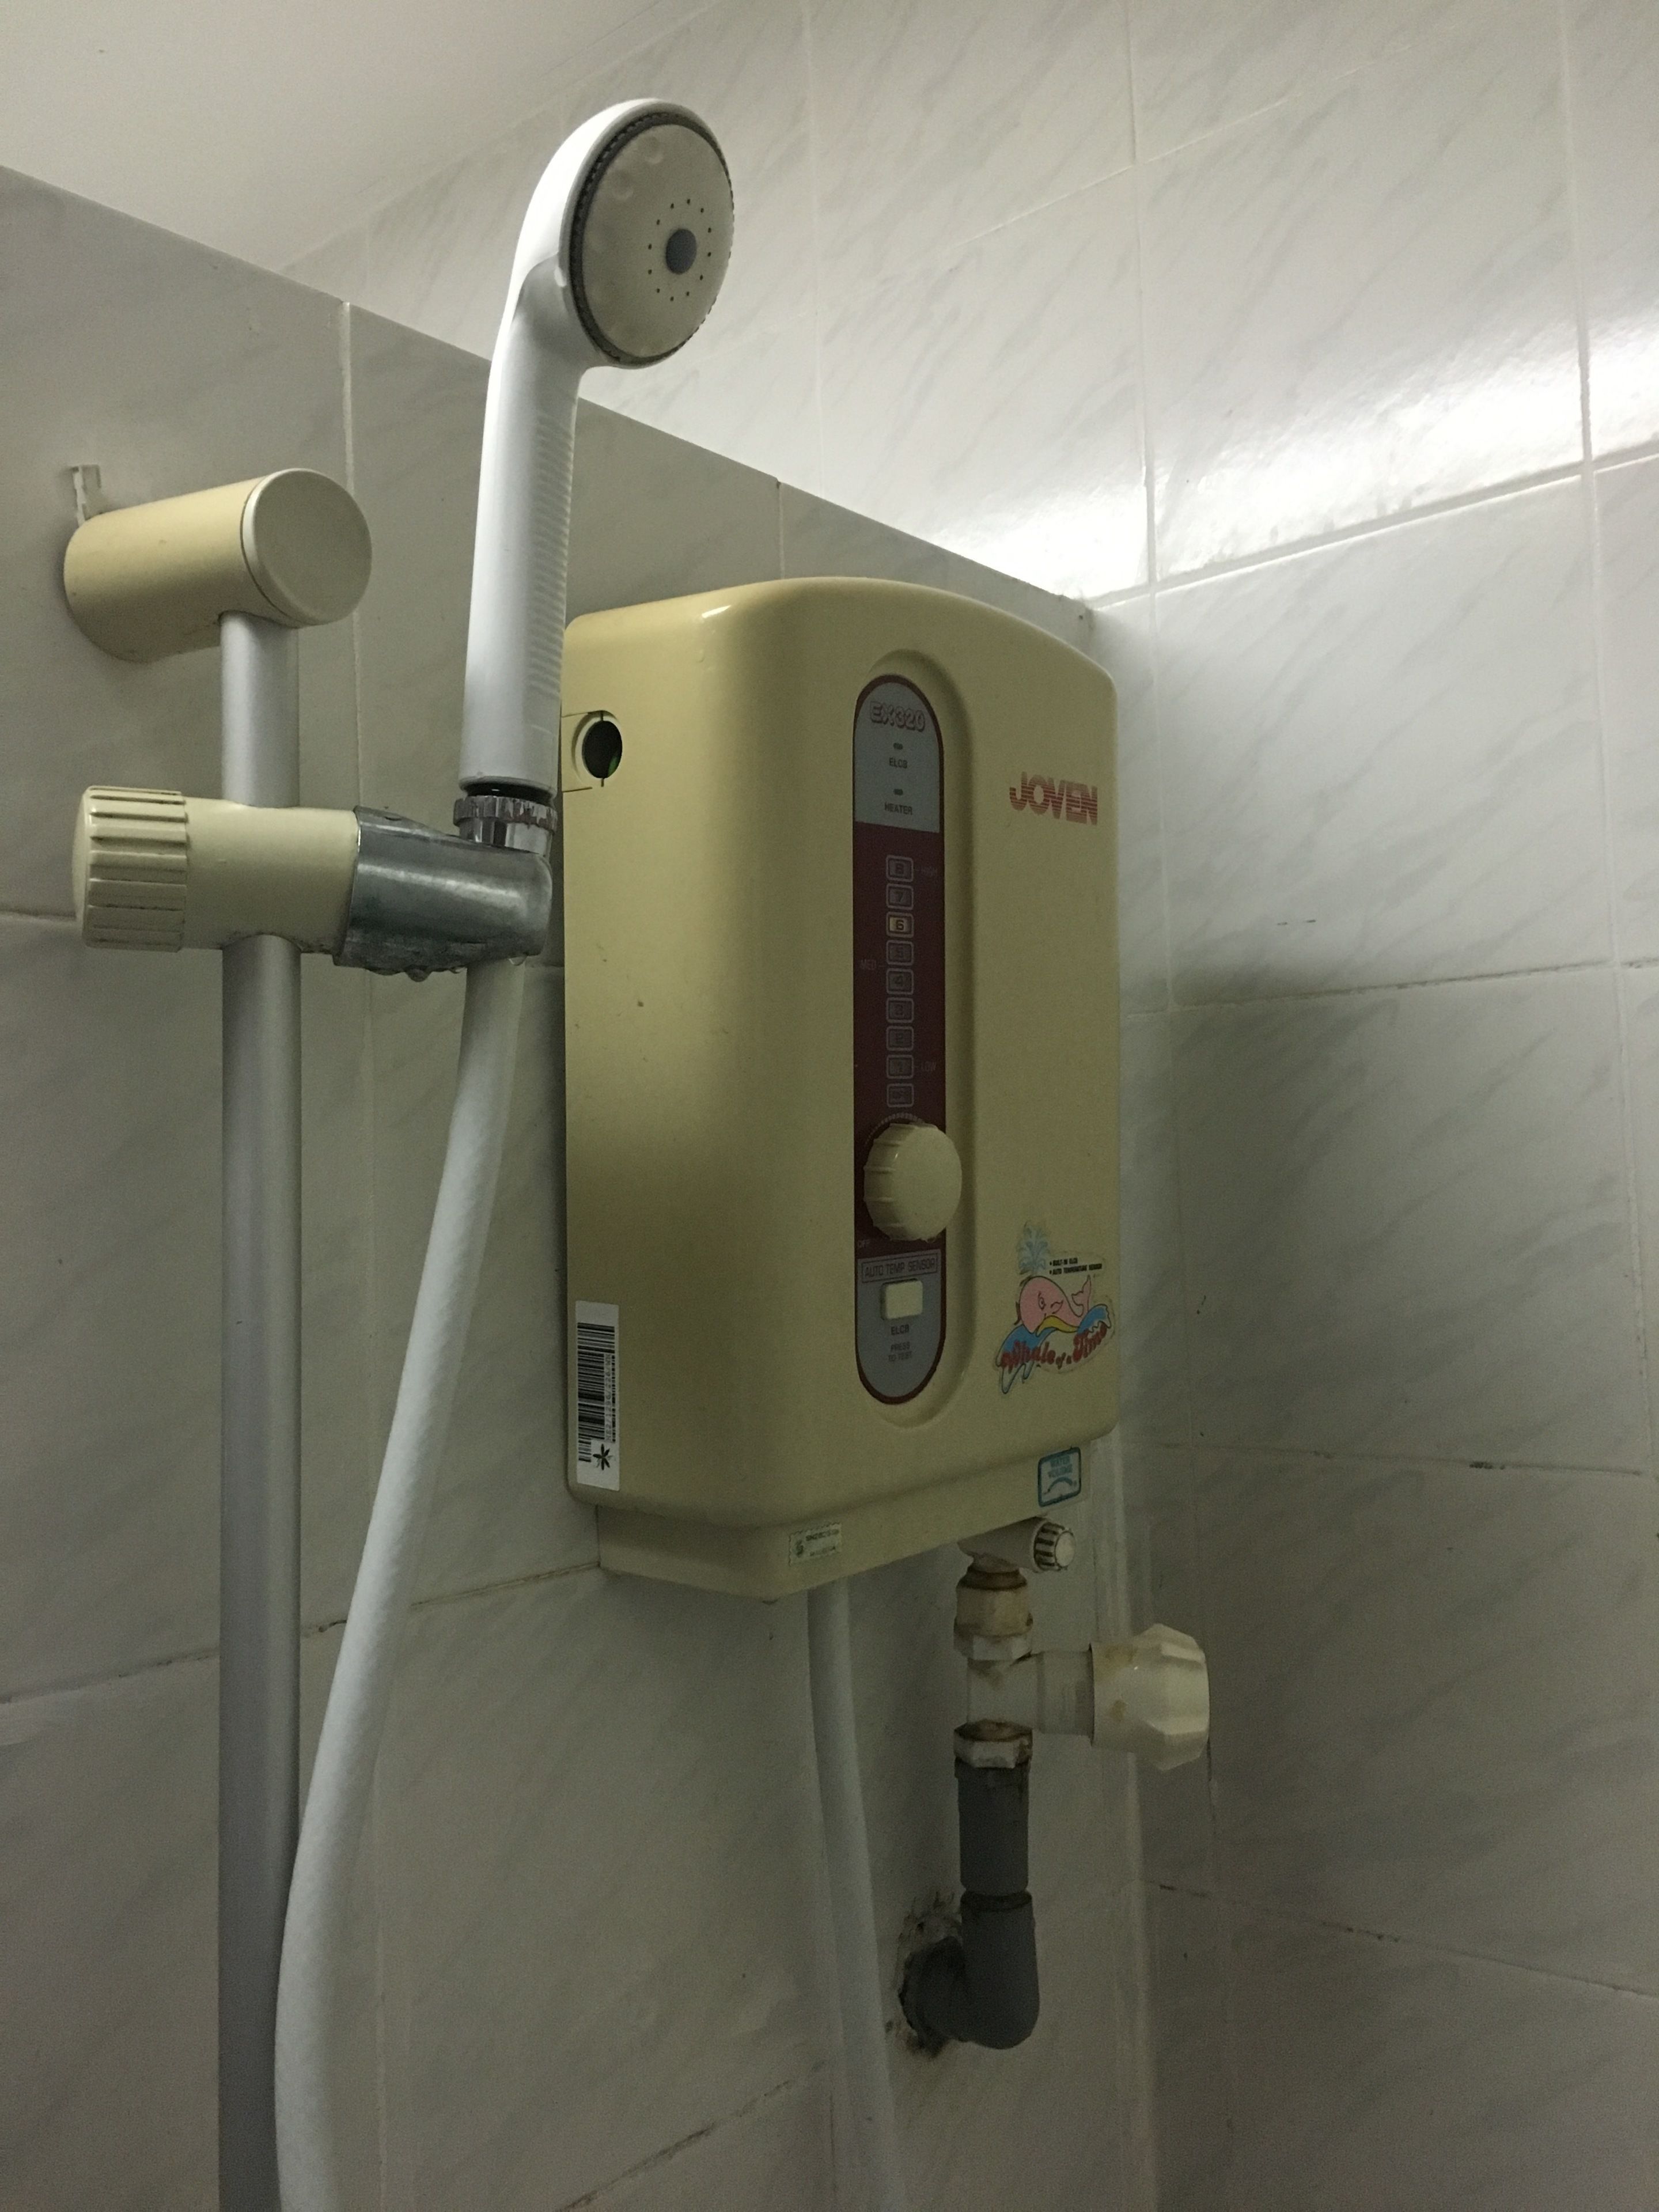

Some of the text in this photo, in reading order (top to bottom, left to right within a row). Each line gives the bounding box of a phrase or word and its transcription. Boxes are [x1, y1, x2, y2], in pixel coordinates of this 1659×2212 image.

[870, 700, 925, 732] EX320
[889, 757, 908, 769] ELCB
[1009, 771, 1097, 825] JOVEN
[884, 802, 912, 815] HEATER
[896, 920, 904, 931] 6
[865, 1258, 935, 1278] AUTO TEMP SENSOR
[891, 1324, 910, 1335] ELCB
[891, 1342, 910, 1352] PRESS
